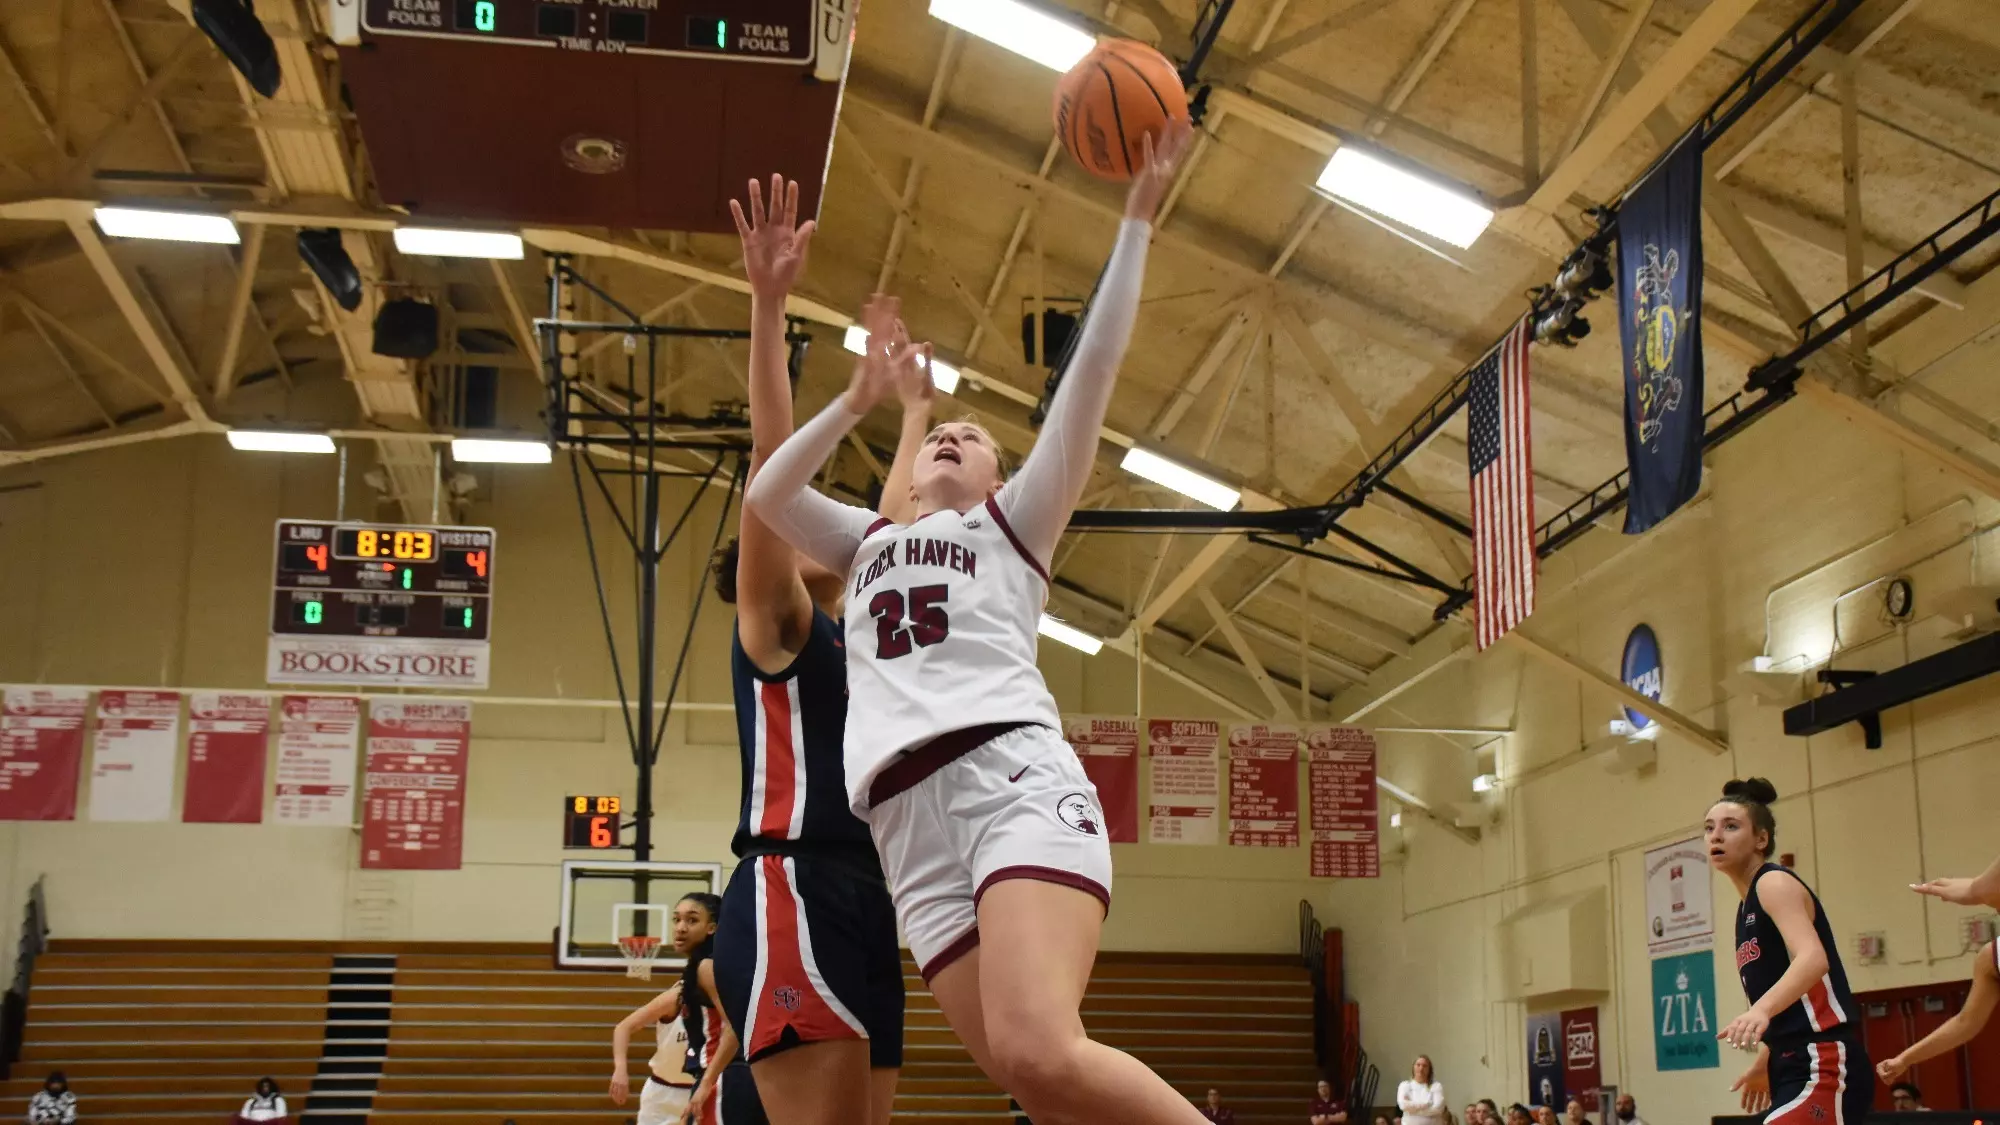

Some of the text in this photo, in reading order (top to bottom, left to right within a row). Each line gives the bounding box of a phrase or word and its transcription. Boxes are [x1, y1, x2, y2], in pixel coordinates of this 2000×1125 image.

[388, 10, 442, 27] FOULS
[475, 1, 495, 31] 0
[717, 19, 726, 49] 1
[742, 22, 788, 38] TEAM
[559, 36, 627, 53] TIME ADV
[738, 36, 790, 53] FOULS
[357, 529, 432, 560] 8:03
[306, 544, 328, 572] 4
[466, 550, 487, 577] 4
[855, 538, 977, 599] LOCK HAVEN
[402, 567, 413, 590] 1
[304, 600, 323, 625] 0
[463, 606, 474, 630] 1
[868, 583, 949, 660] 25
[280, 651, 476, 678] BOOKSTORE
[403, 704, 467, 720] WRESTLING
[1091, 719, 1138, 734] BASEBALL
[1171, 721, 1219, 736] SOFTBALL
[574, 796, 620, 814] 8 03
[590, 816, 612, 849] 6
[1660, 993, 1709, 1037] ZTA
